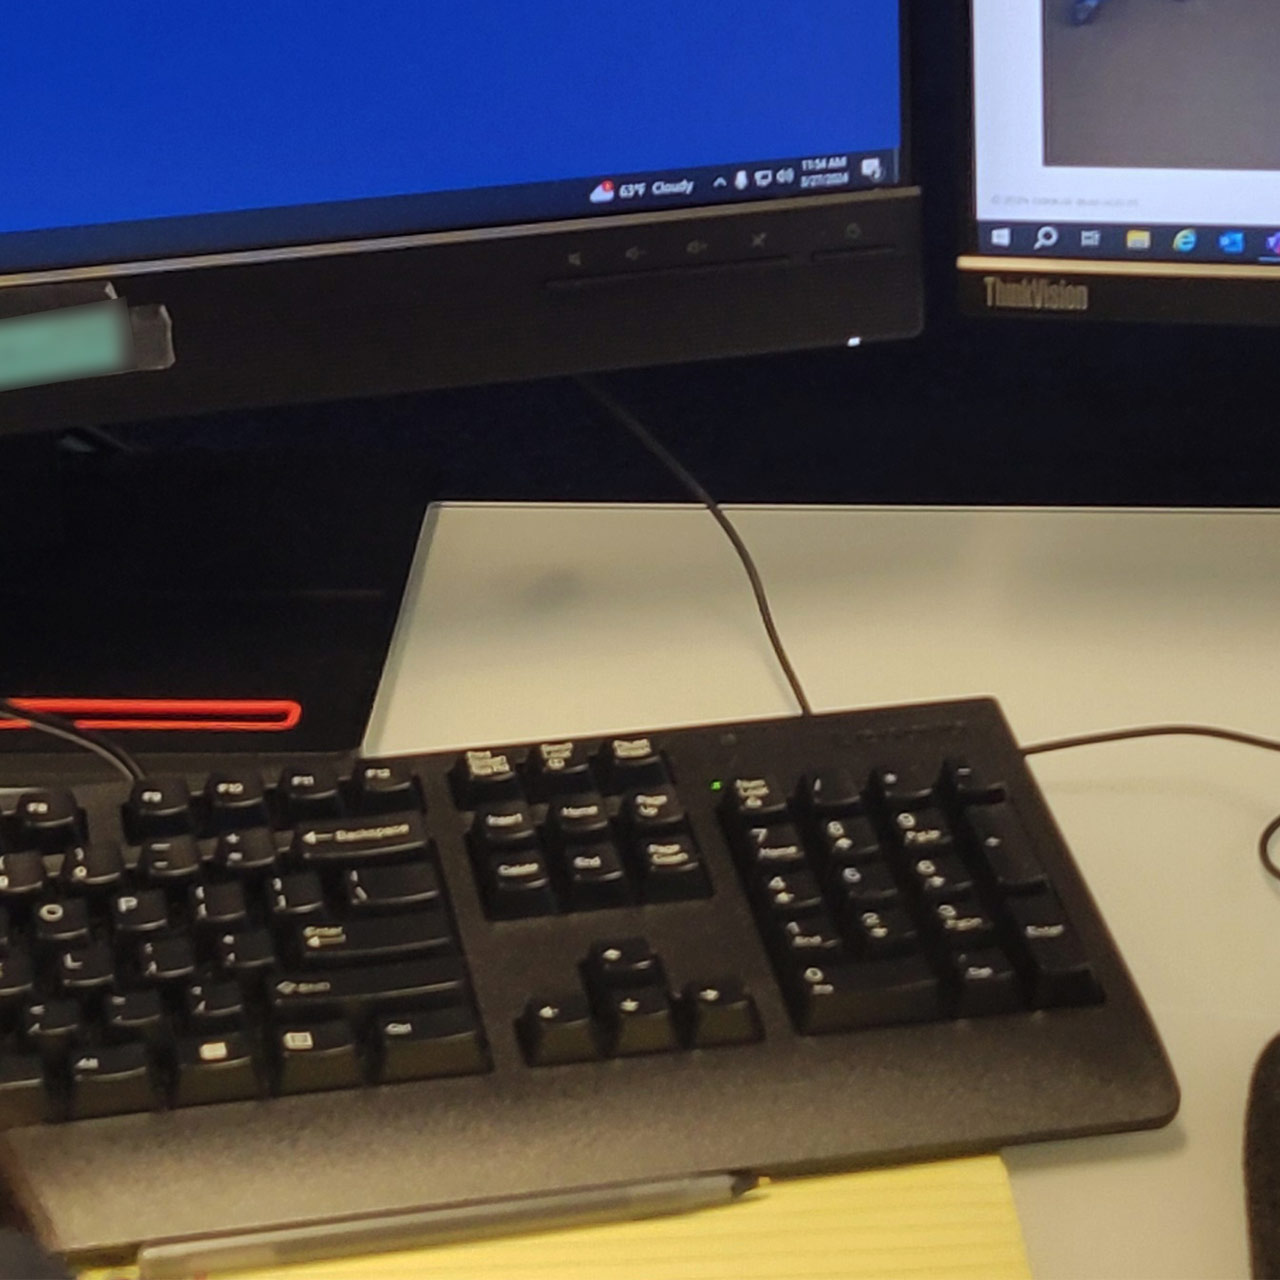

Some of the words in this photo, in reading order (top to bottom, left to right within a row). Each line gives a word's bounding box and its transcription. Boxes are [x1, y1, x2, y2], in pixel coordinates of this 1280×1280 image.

[651, 179, 695, 196] Cloudy
[983, 275, 1090, 311] ThinkVision
[117, 896, 138, 912] P
[62, 952, 83, 970] L
